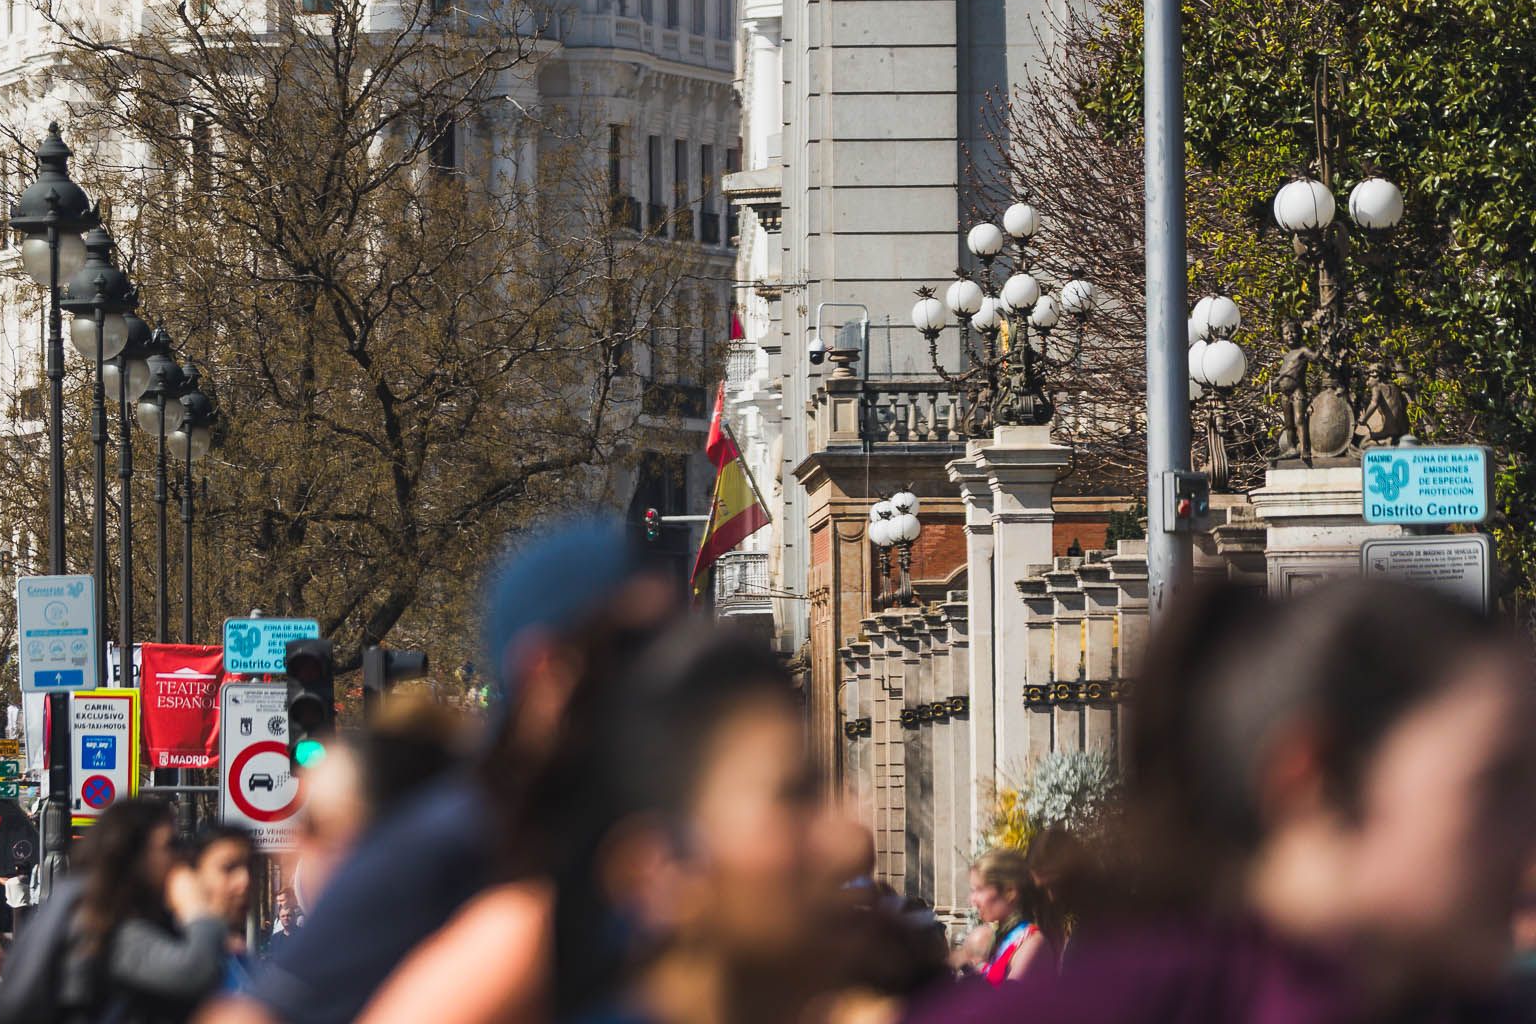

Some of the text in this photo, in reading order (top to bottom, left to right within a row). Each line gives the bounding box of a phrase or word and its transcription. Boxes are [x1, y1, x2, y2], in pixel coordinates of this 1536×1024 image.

[1413, 454, 1478, 464] ZONA DE BAJAS
[1423, 465, 1468, 474] EMISIONES
[1432, 477, 1472, 485] ESPECIAL
[1372, 503, 1478, 517] Distrito Centro
[231, 659, 271, 669] Distrito
[156, 680, 216, 695] TEATRO
[157, 695, 220, 710] ESPAÑOL
[170, 755, 209, 765] MADRID
